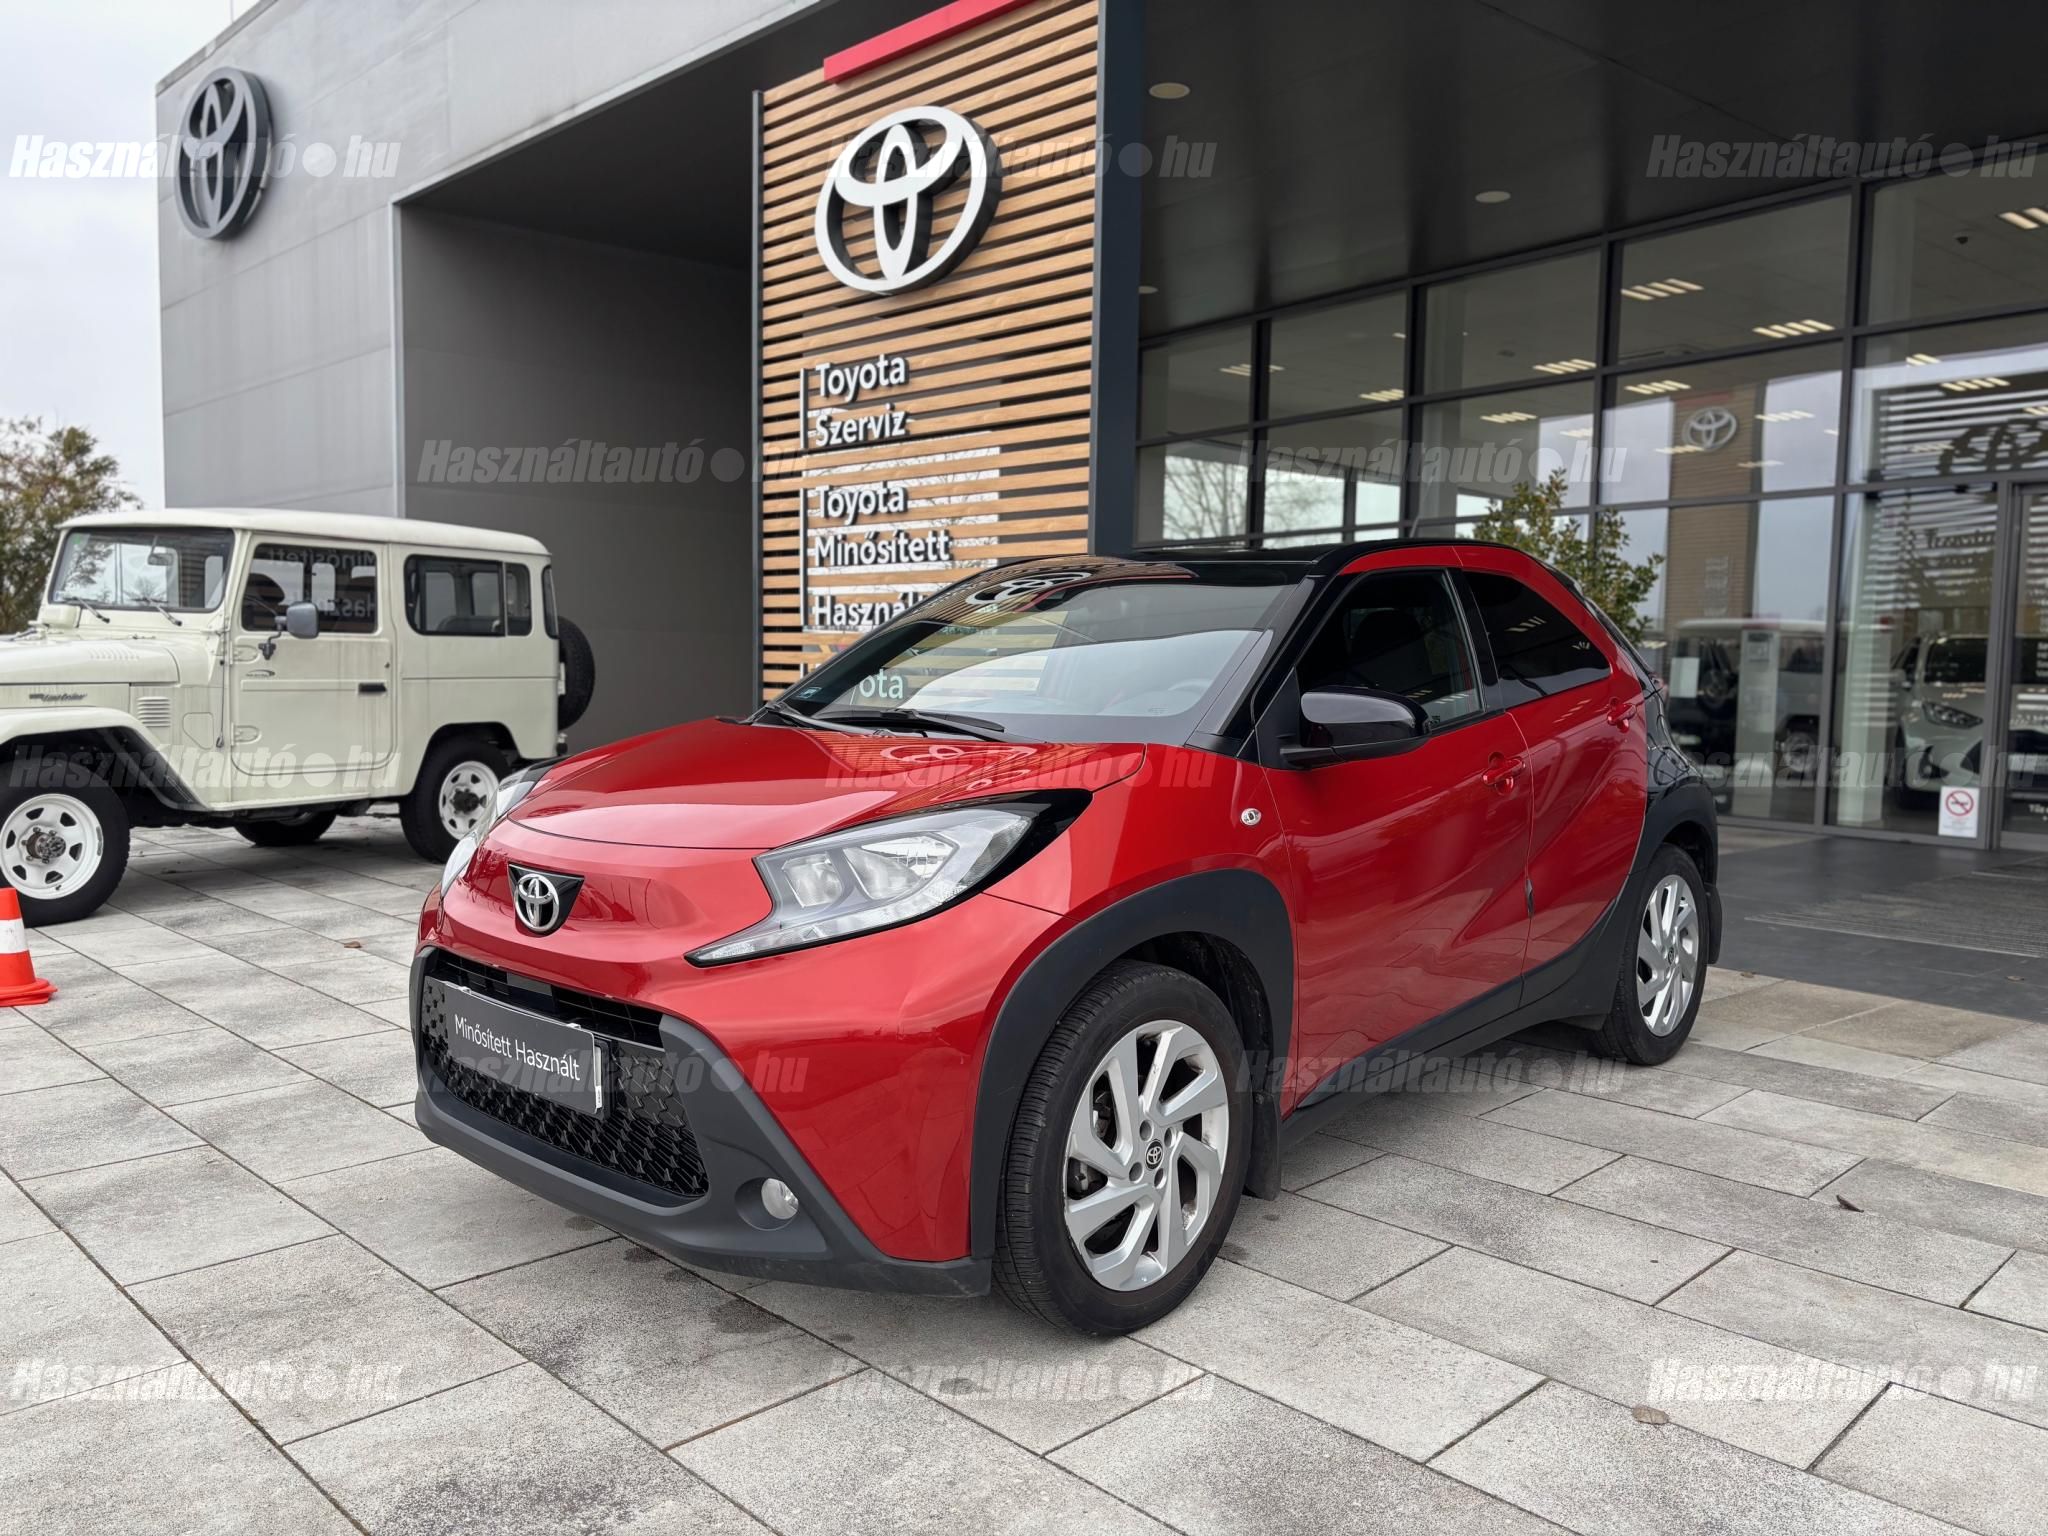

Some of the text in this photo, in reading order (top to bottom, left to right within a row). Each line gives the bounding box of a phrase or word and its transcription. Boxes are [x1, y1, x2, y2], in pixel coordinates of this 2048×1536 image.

[816, 354, 906, 402] Toyota
[815, 403, 905, 446] Szerviz
[815, 482, 904, 525] Toyota
[814, 529, 950, 566] Minősített
[814, 591, 929, 627] Használ
[454, 1013, 581, 1081] Minősített Használt
